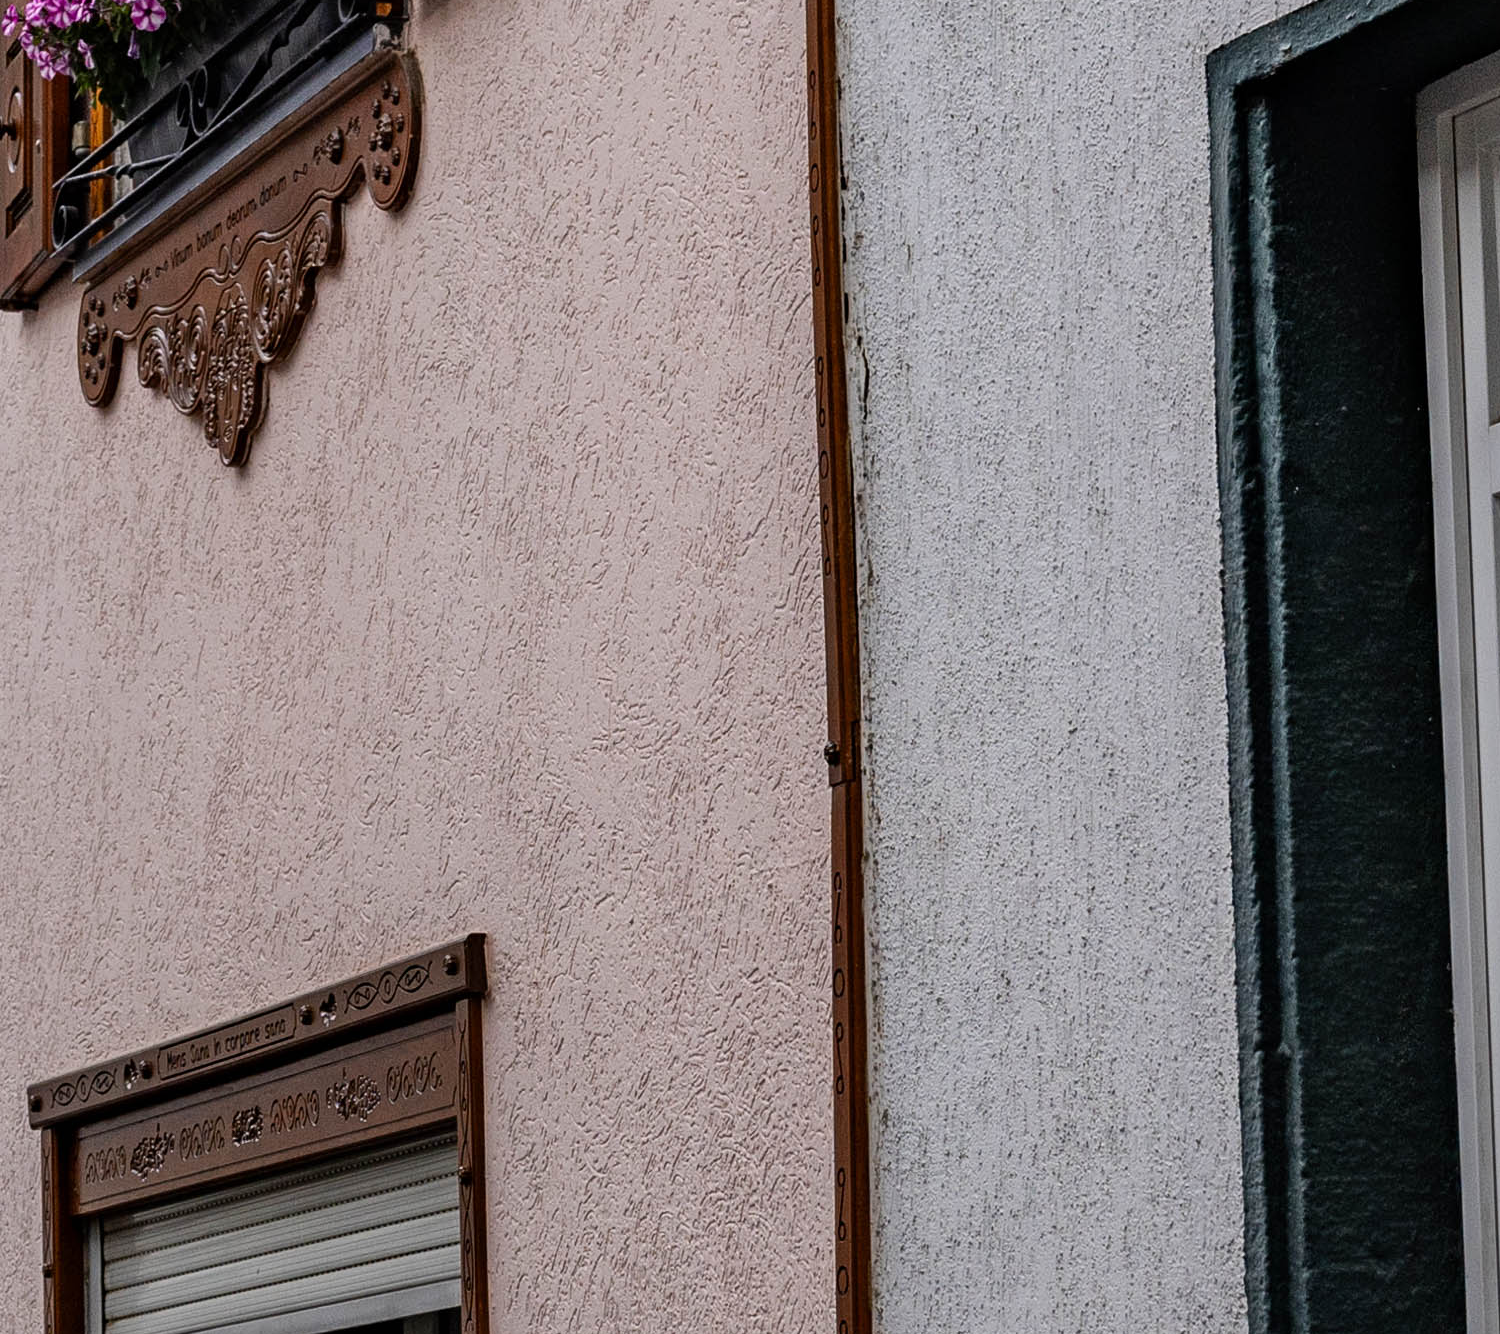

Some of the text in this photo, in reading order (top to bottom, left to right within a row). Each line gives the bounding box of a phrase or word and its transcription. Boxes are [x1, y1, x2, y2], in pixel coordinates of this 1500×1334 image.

[196, 222, 223, 252] bonum
[259, 176, 287, 207] donum
[166, 1050, 187, 1072] Mens
[224, 1026, 260, 1053] corpore
[264, 1018, 287, 1040] sano
